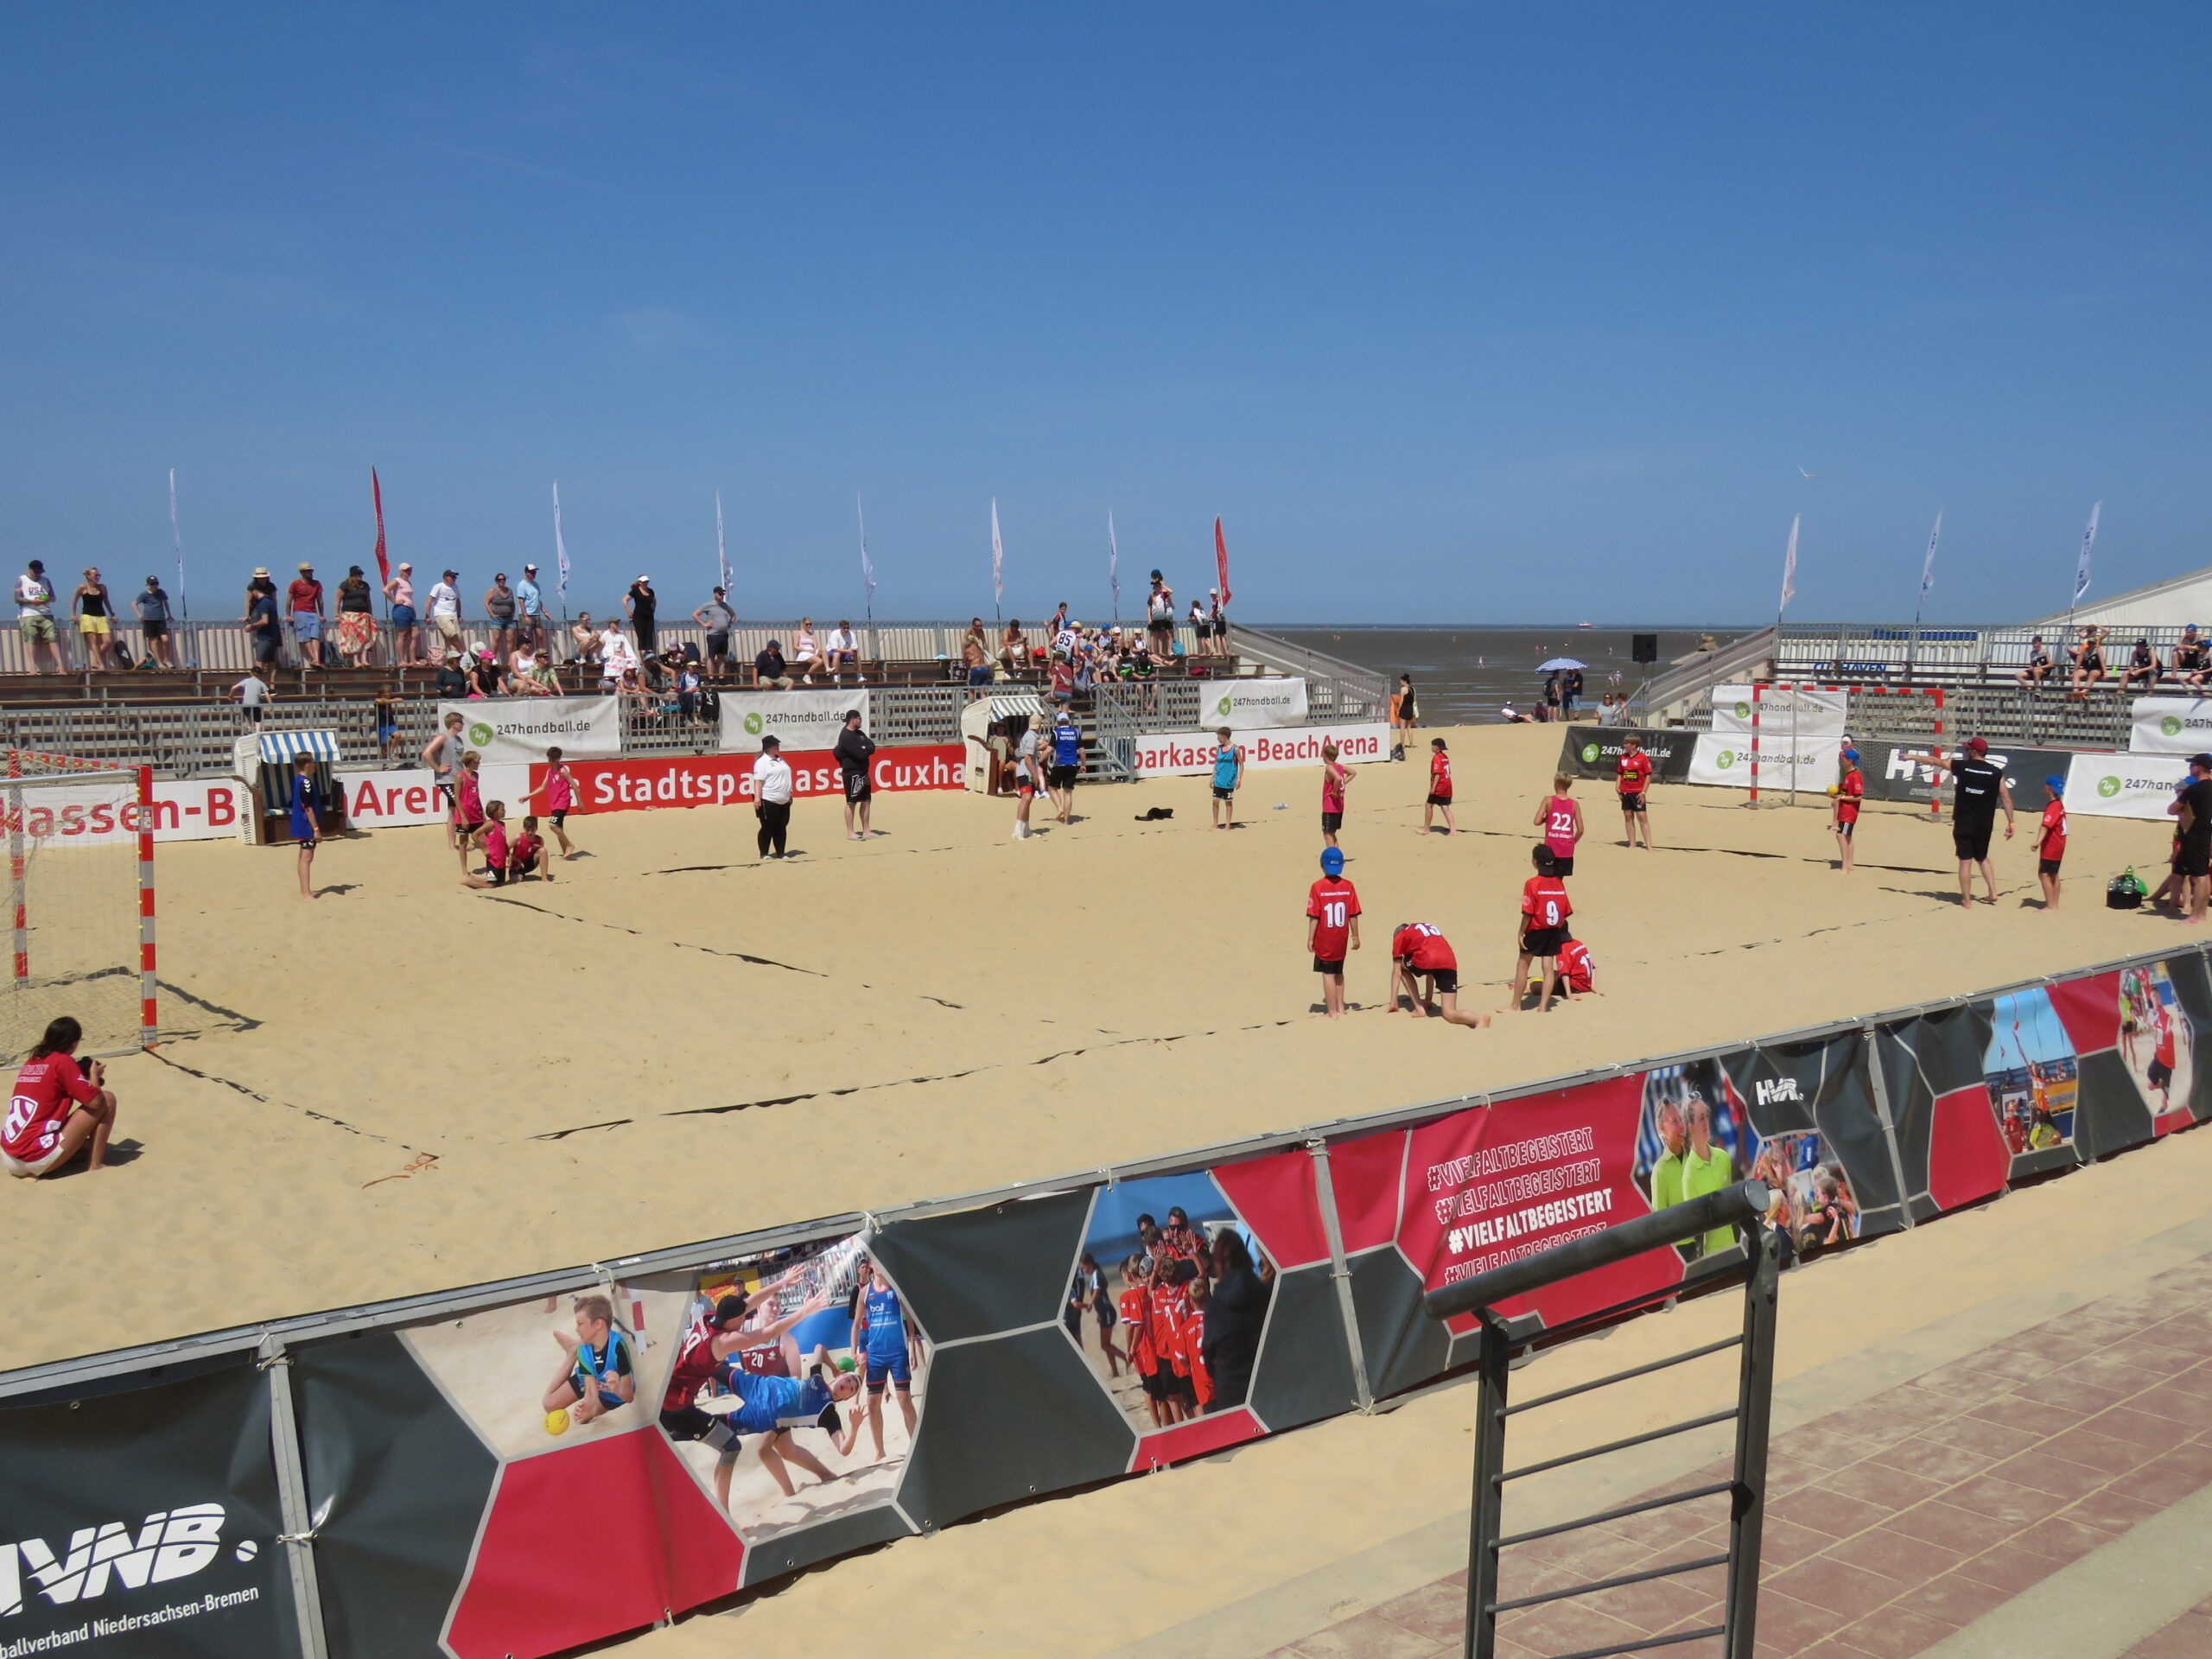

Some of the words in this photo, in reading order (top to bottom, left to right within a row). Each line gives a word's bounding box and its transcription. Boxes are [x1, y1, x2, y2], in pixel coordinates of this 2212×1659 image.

[1058, 632, 1072, 646] 85
[1233, 696, 1291, 707] 247handball.de
[497, 720, 590, 735] 247handball.de
[766, 711, 847, 724] 247handball.de
[1551, 812, 1571, 831] 22
[1324, 901, 1346, 928] 10
[1546, 900, 1559, 926] 9
[1427, 1126, 1594, 1191] #VIELFALTBEGEISTERT
[1434, 1158, 1600, 1224] #VIELFALTBEGEISTERT
[1448, 1187, 1612, 1255] #VIELFALTBEGEISTERT
[751, 1351, 764, 1368] 20
[93, 1586, 259, 1637] Niedersachsen-Bremen
